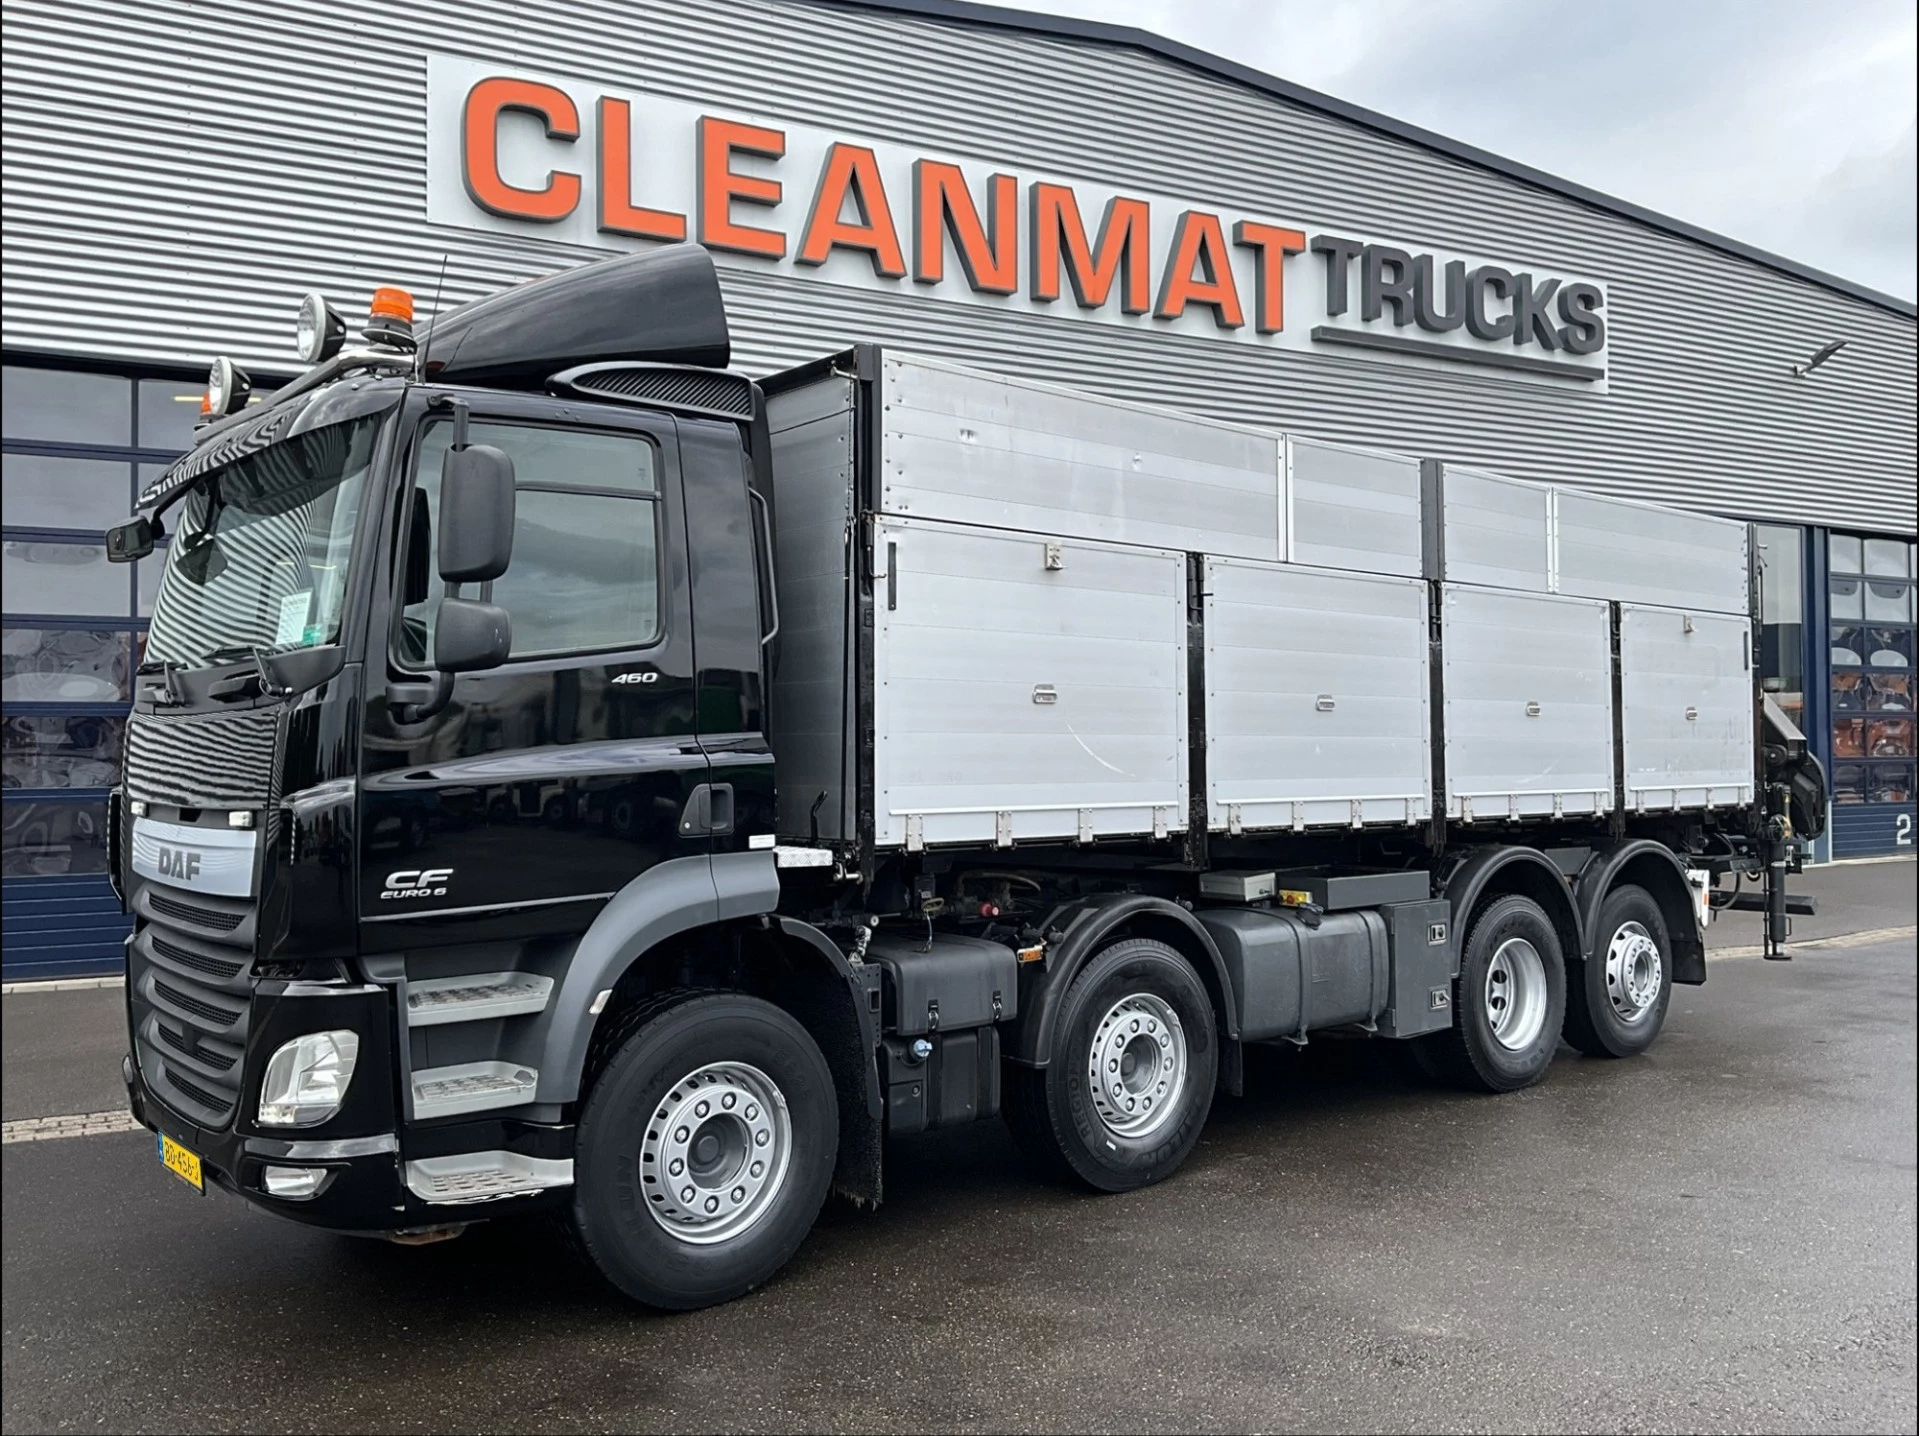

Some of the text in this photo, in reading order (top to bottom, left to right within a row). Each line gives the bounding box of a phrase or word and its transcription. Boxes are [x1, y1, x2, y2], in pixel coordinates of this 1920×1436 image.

[461, 76, 1605, 355] CLEANMAT TRUCKS
[611, 672, 658, 685] 460
[1896, 813, 1912, 846] 2
[158, 847, 201, 881] DAF
[385, 868, 454, 889] CF
[380, 887, 447, 899] EURO 6
